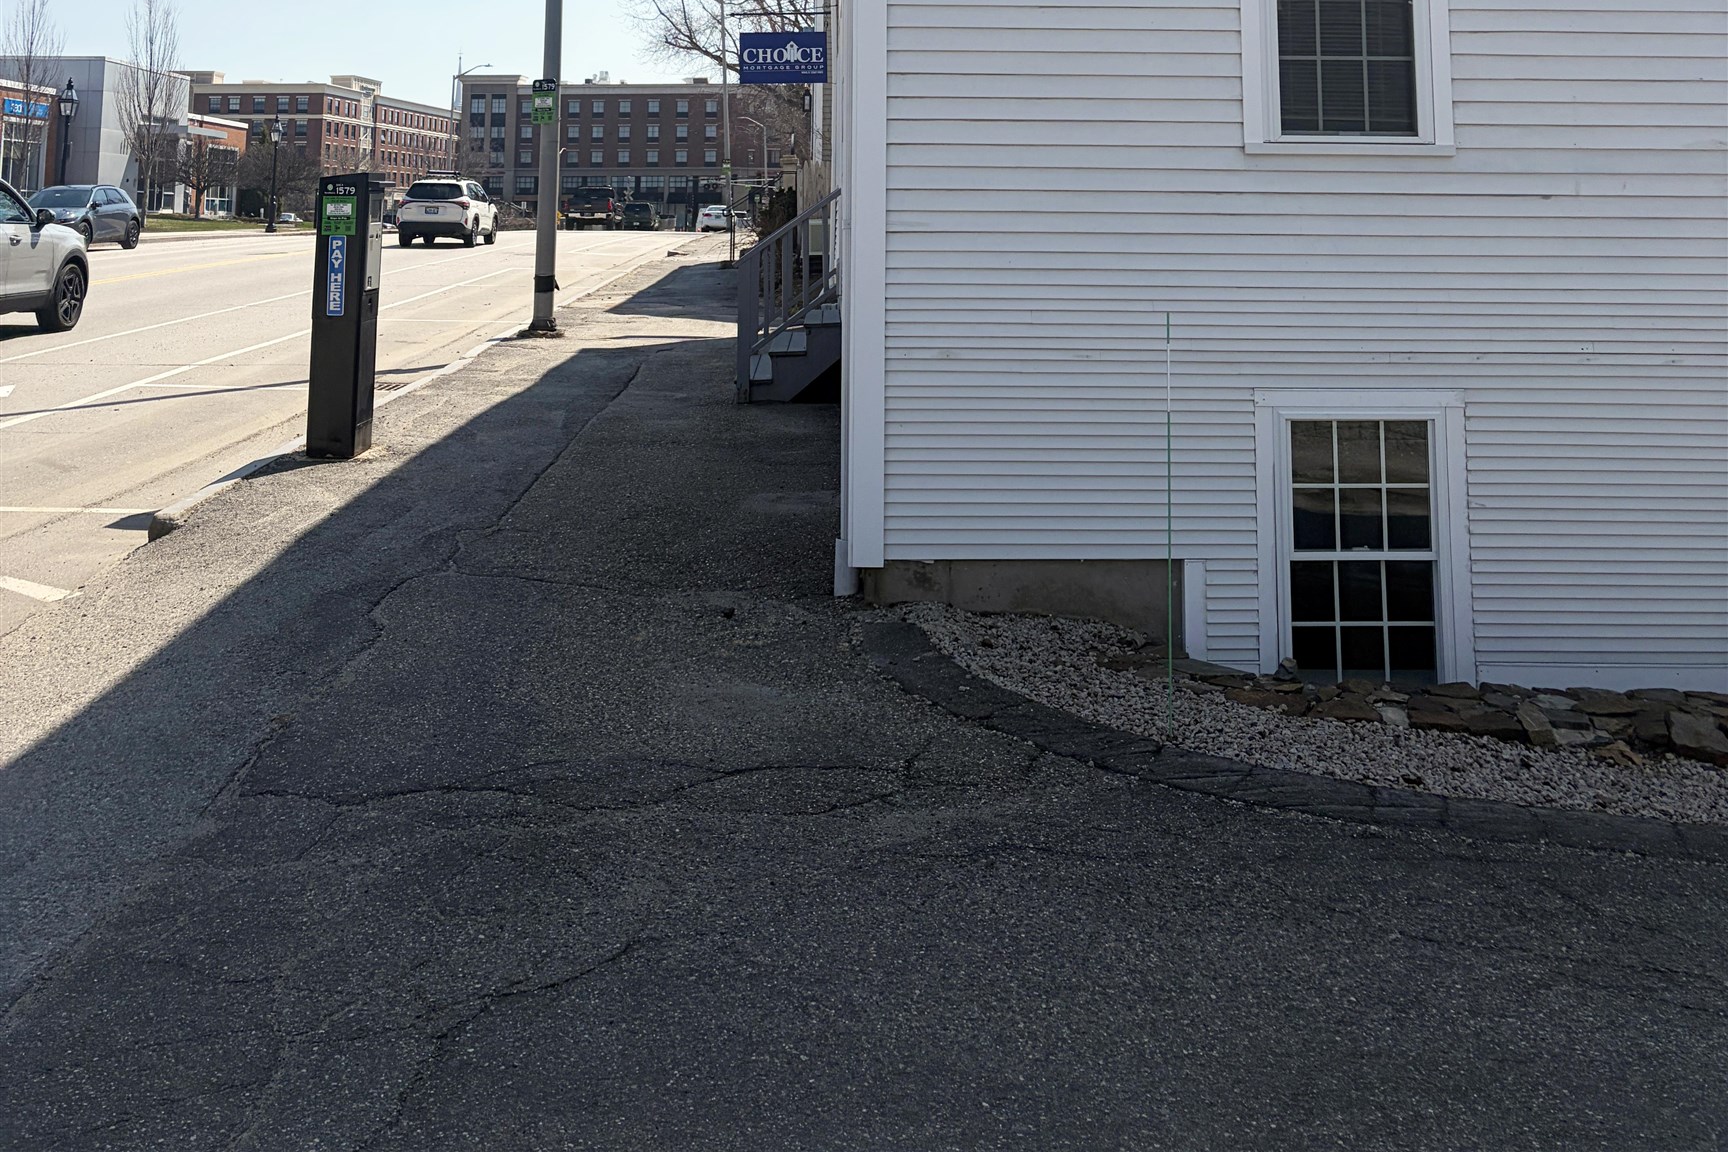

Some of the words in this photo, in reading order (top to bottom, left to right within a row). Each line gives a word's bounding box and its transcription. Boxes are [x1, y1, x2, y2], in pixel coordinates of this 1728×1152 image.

[743, 42, 824, 63] CHOICE
[336, 186, 356, 195] 1579
[331, 240, 343, 269] PAY
[329, 273, 342, 311] HERE
